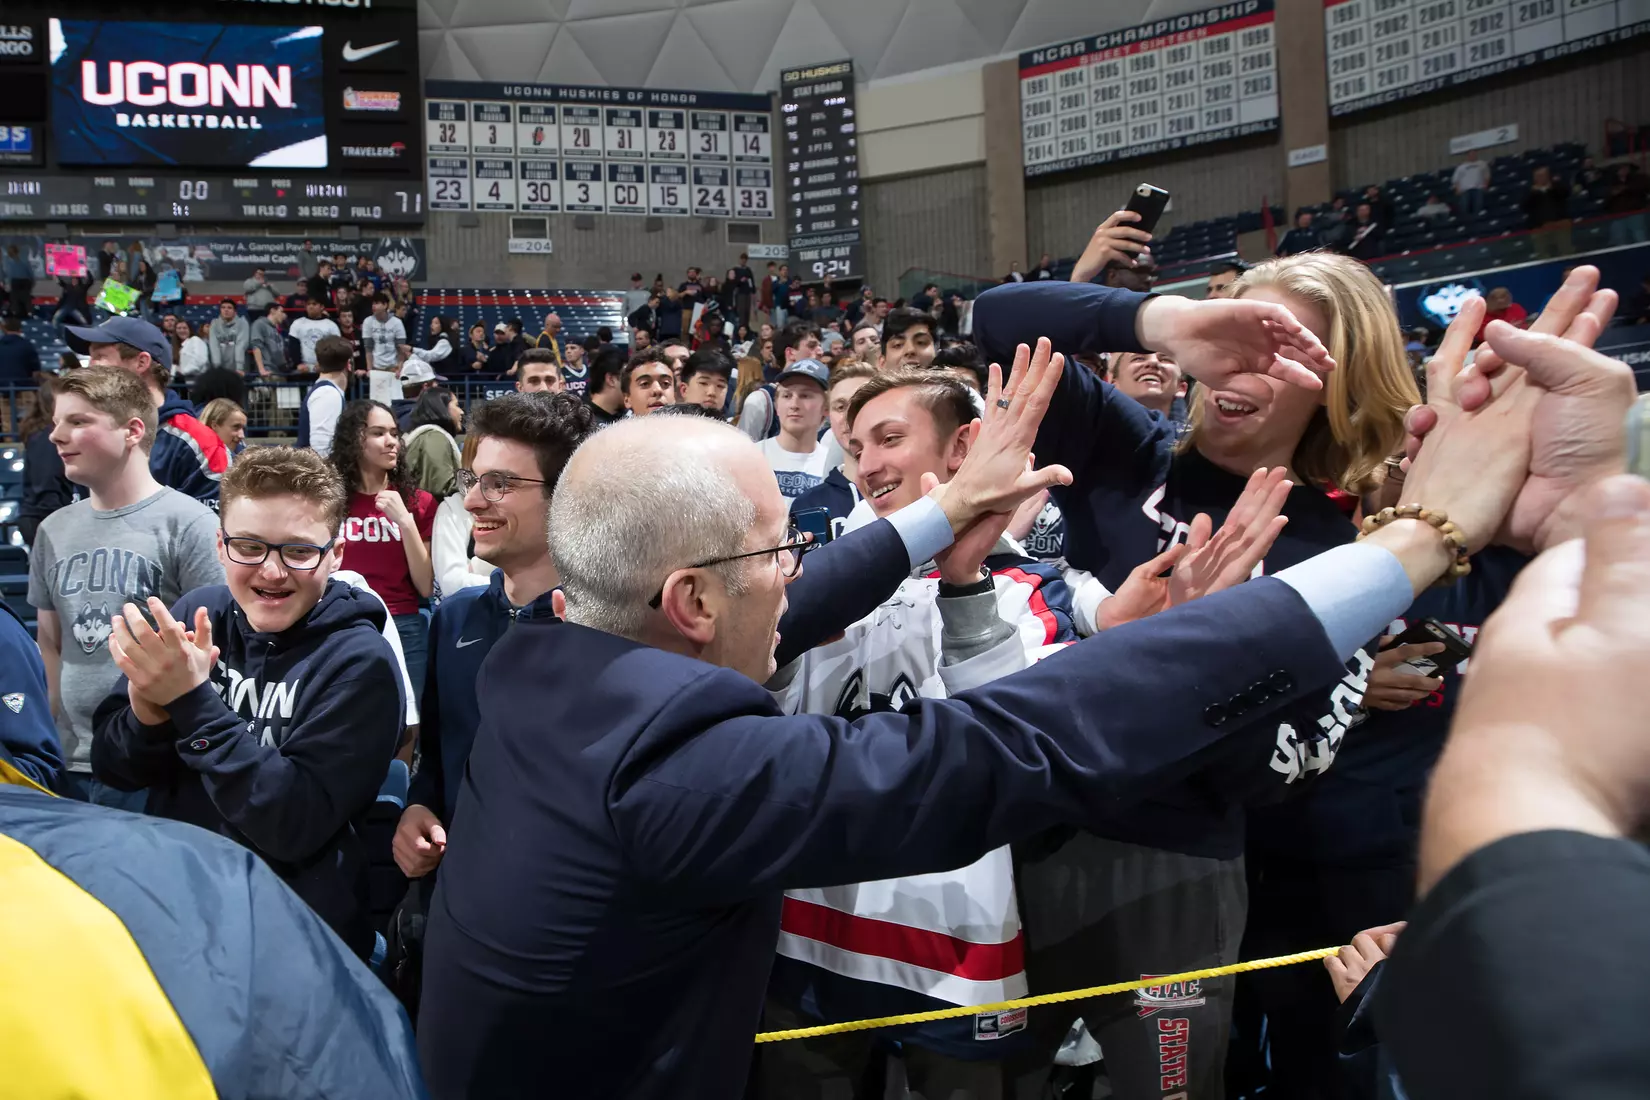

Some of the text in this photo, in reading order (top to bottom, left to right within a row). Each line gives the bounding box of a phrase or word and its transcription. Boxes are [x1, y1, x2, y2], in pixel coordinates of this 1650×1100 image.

[1033, 2, 1258, 64] NCAA CHAMPIONSHIP
[1374, 15, 1408, 38] 2002
[1422, 26, 1456, 50] 2011
[1470, 13, 1504, 36] 2012
[1520, 0, 1554, 22] 2013
[1080, 46, 1131, 66] SWEET
[1027, 78, 1049, 95] 1991
[1060, 71, 1084, 89] 1994
[1167, 46, 1192, 64] 1997
[1377, 65, 1409, 87] 2017
[82, 60, 292, 108] UCONN
[504, 86, 698, 104] UCONN HUSKIES OF HONOR
[1060, 93, 1085, 108] 2001
[1094, 85, 1121, 101] 2002
[1130, 77, 1157, 94] 2003
[1166, 70, 1194, 87] 2004
[1026, 122, 1051, 139] 2007
[1168, 93, 1195, 110] 2011
[1205, 84, 1232, 102] 2012
[1244, 76, 1271, 93] 2013
[1331, 77, 1448, 116] CONNECTICUT
[116, 112, 262, 129] BASKETBALL
[440, 124, 760, 154] 32 3 20 31 23 31 14
[1026, 121, 1277, 176] CONNECTICUT WOMEN'S BASKETBALL
[1028, 144, 1052, 161] 2014
[1062, 137, 1087, 155] 2015
[1132, 123, 1158, 140] 2017
[342, 146, 394, 157] TRAVELERS
[394, 192, 421, 214] 71
[436, 180, 767, 208] 23 4 30 3 CD 15 24 33
[70, 204, 89, 214] SEC
[130, 204, 146, 215] FLS
[242, 205, 274, 216] TM FLS
[312, 206, 329, 217] SEC
[351, 206, 372, 217] FULL
[210, 242, 235, 251] Harry
[249, 243, 285, 251] Gampel
[526, 242, 551, 251] 204
[800, 246, 850, 261] TIME OF DAY
[812, 260, 850, 278] 9:24
[1158, 1018, 1190, 1090] STATE
